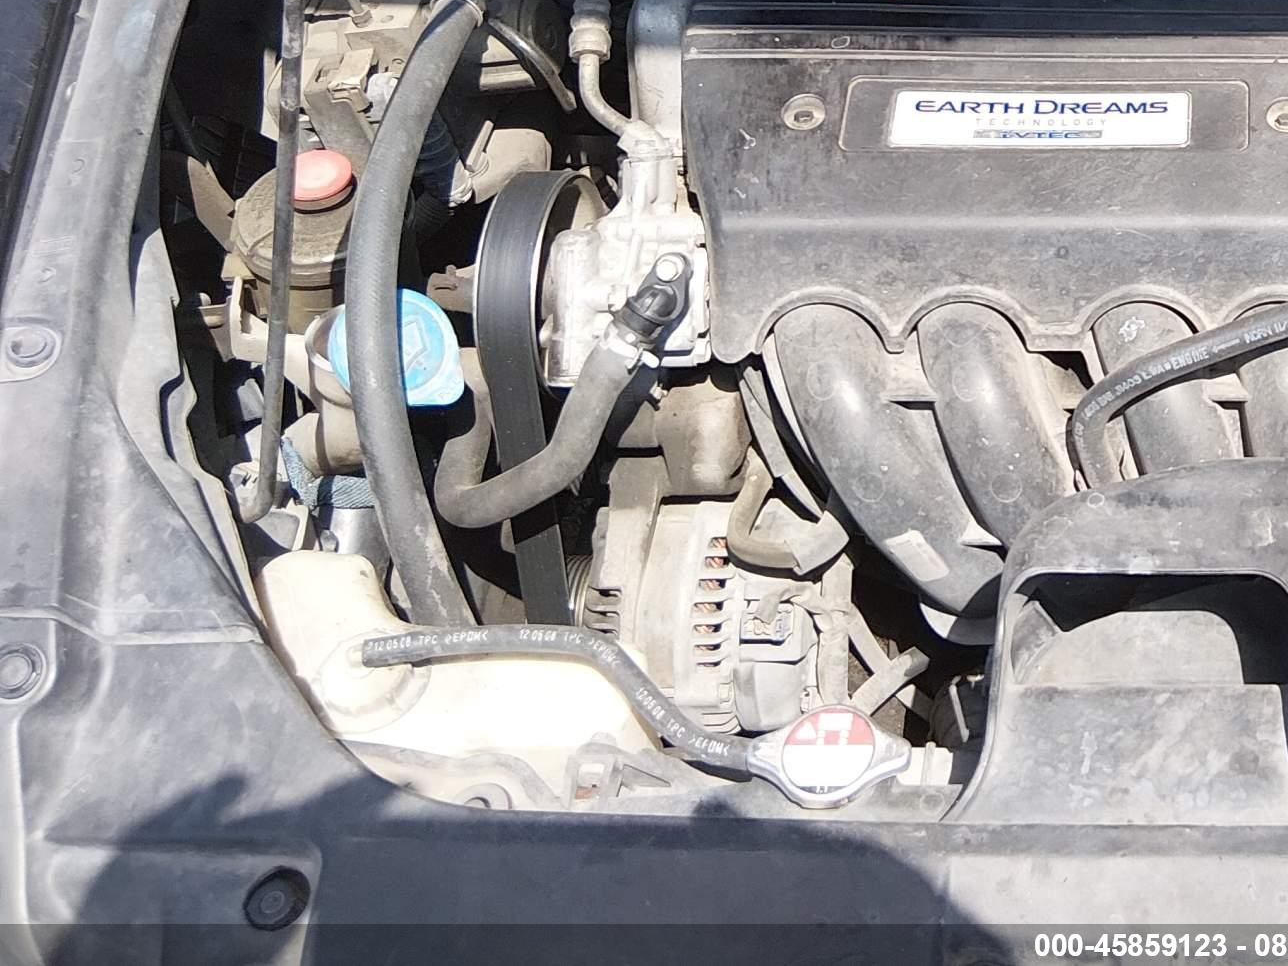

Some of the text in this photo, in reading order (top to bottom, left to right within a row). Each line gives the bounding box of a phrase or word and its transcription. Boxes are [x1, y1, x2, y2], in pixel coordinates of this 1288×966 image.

[915, 100, 1169, 114] EARTH DREAMS
[975, 118, 1107, 127] TECHNOLOGY
[1172, 347, 1210, 371] ENGINE
[418, 634, 438, 645] TPC
[666, 718, 686, 738] TPC
